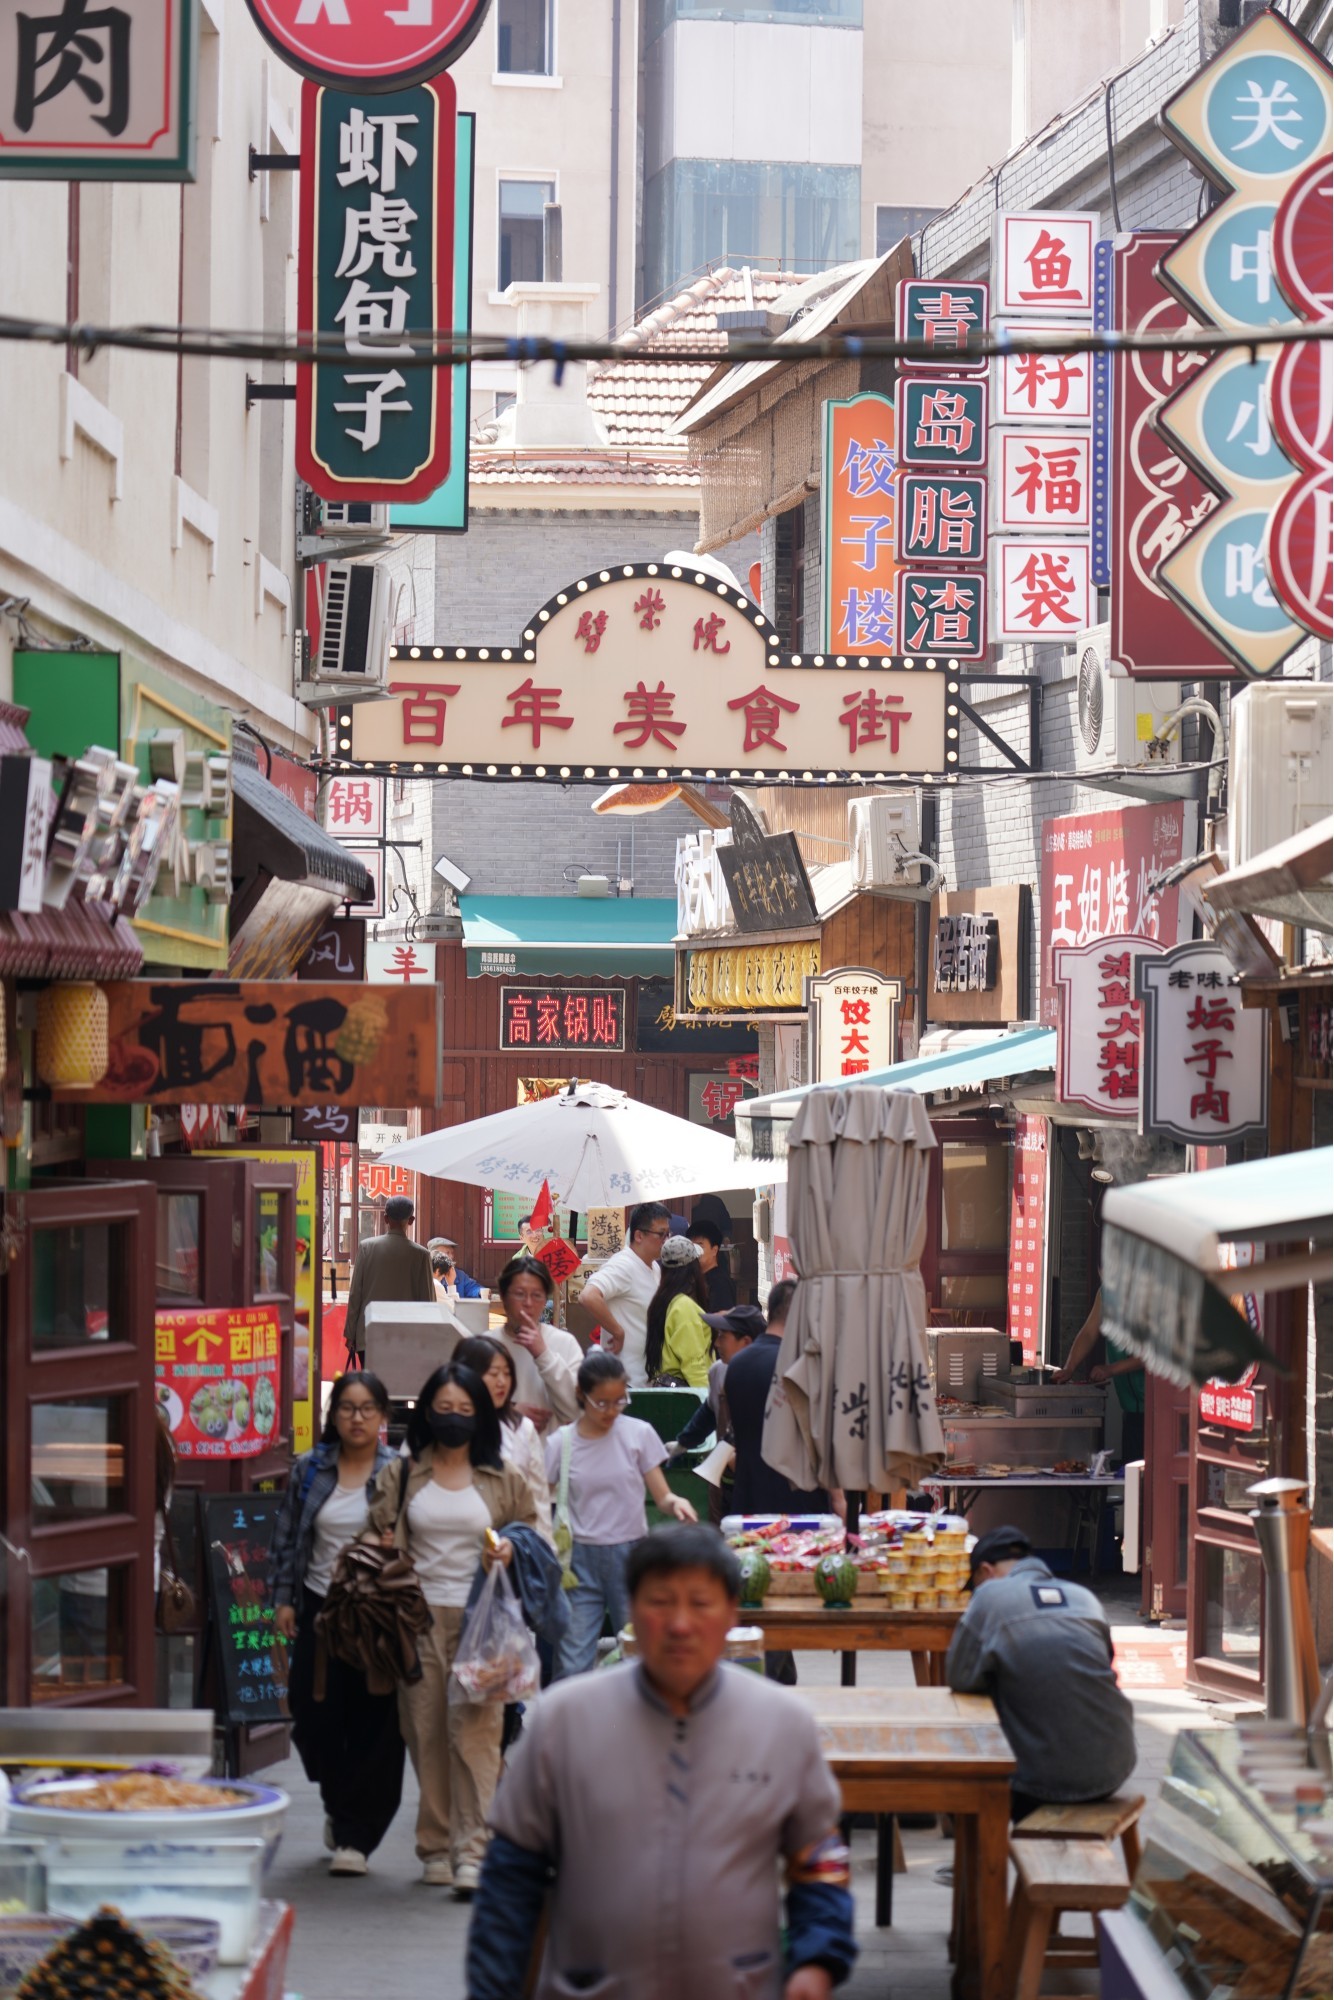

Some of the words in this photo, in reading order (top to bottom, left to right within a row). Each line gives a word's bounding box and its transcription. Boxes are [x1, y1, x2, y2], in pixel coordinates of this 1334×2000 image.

[13, 0, 131, 137] 肉
[334, 108, 418, 452] 虾虎包子
[908, 292, 977, 651] 青岛脂渣
[1012, 229, 1084, 628] 鱼籽福袋
[839, 439, 897, 649] 饺子楼
[575, 587, 730, 655] 劈柴院
[388, 675, 912, 754] 百年美食街
[329, 781, 373, 825] 锅
[507, 994, 618, 1043] 高家锅贴
[834, 986, 878, 995] 百年饺子楼
[1184, 995, 1236, 1124] 坛子肉
